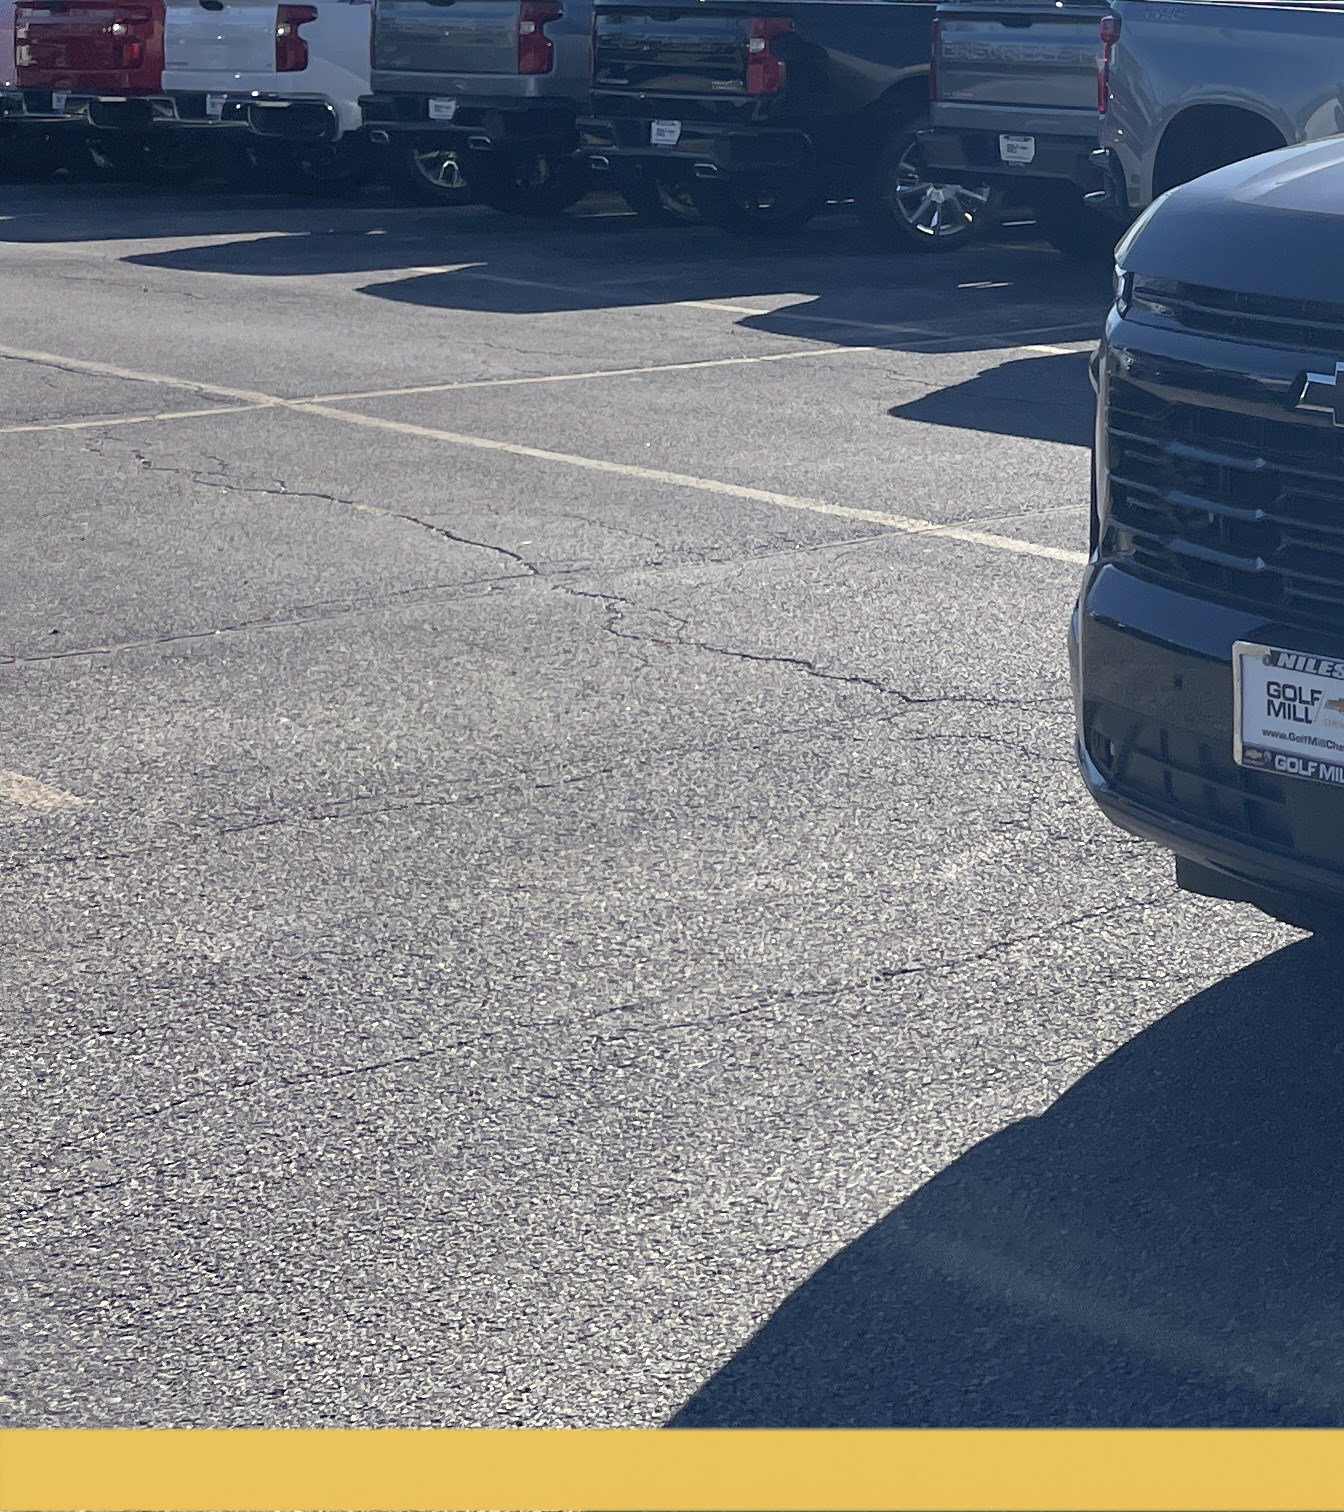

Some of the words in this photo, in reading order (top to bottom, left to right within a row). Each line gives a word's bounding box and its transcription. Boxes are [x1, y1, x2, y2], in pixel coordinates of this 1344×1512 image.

[1266, 680, 1323, 706] GOLF
[1266, 699, 1313, 724] MILL
[1274, 754, 1318, 777] GOLF
